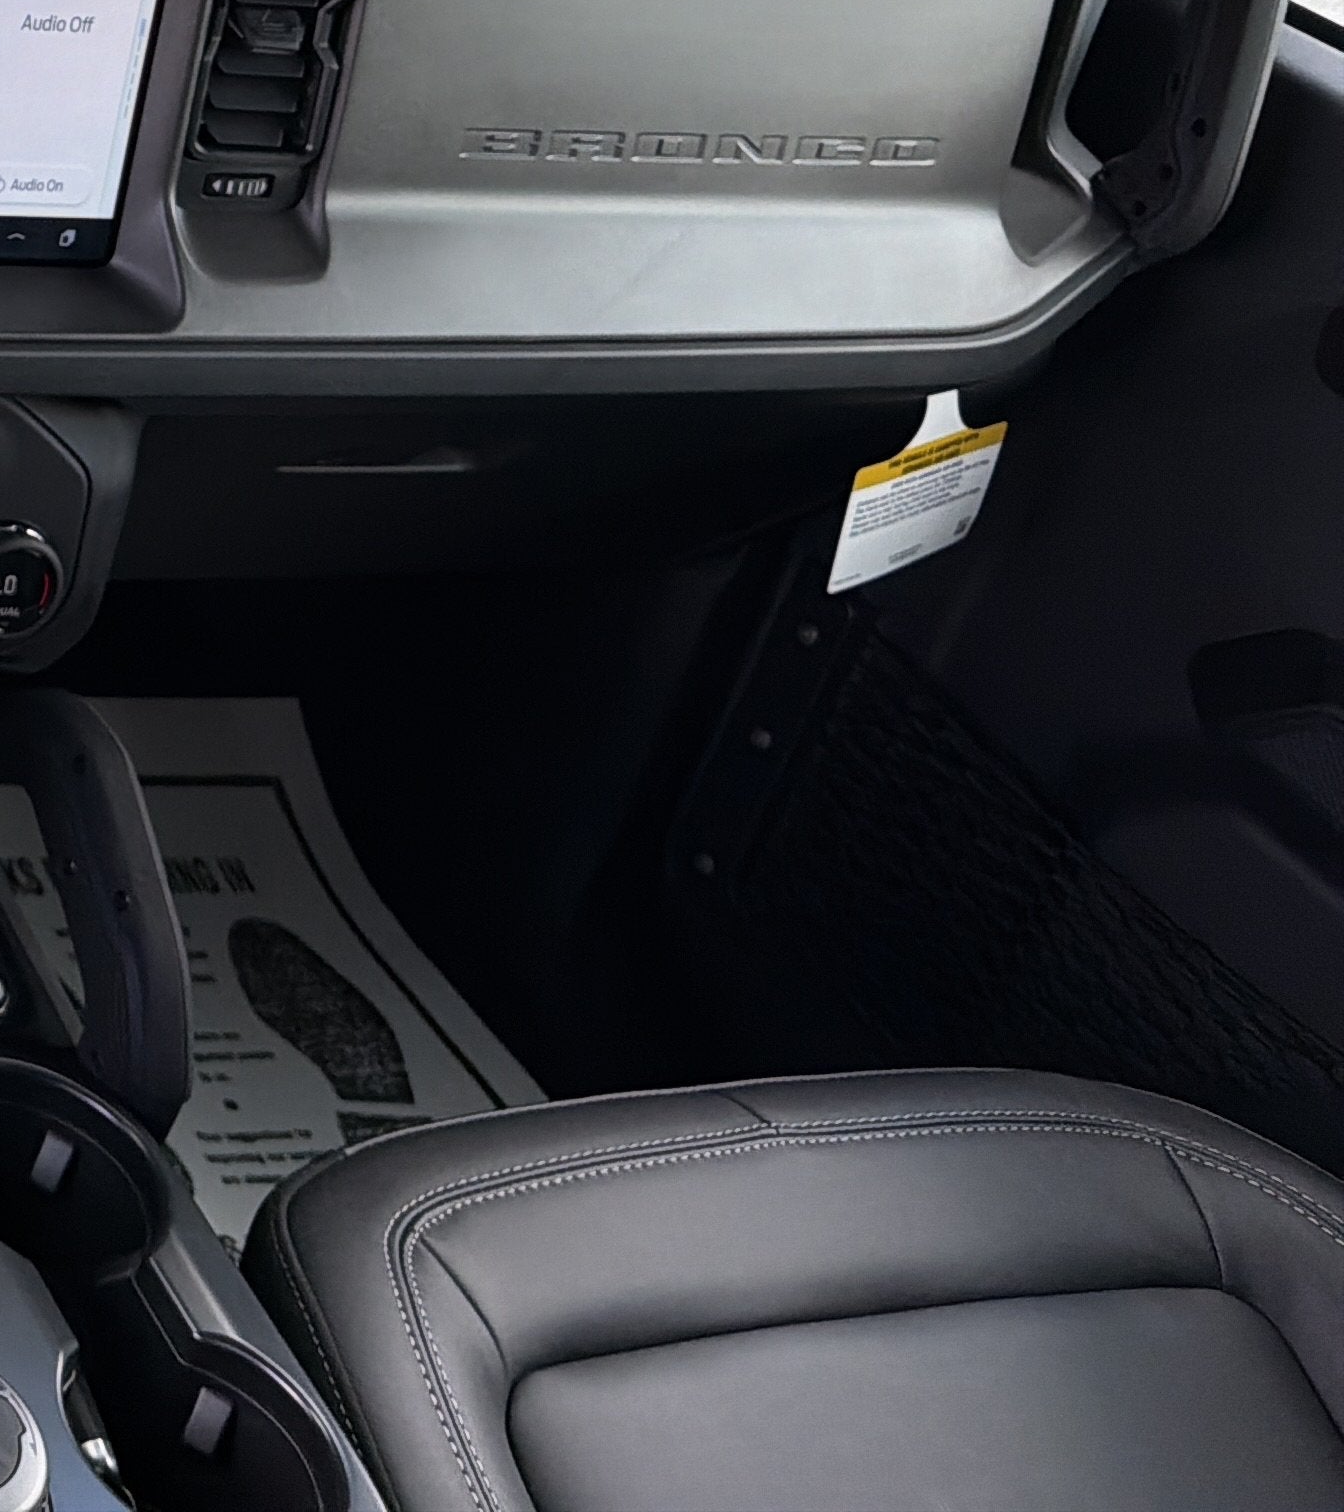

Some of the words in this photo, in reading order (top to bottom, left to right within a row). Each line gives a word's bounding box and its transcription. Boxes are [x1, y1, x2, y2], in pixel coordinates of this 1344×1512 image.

[20, 14, 67, 32] Audio
[69, 15, 96, 33] Off
[458, 126, 941, 167] BRONCO
[10, 178, 45, 192] Audio
[46, 179, 64, 193] On
